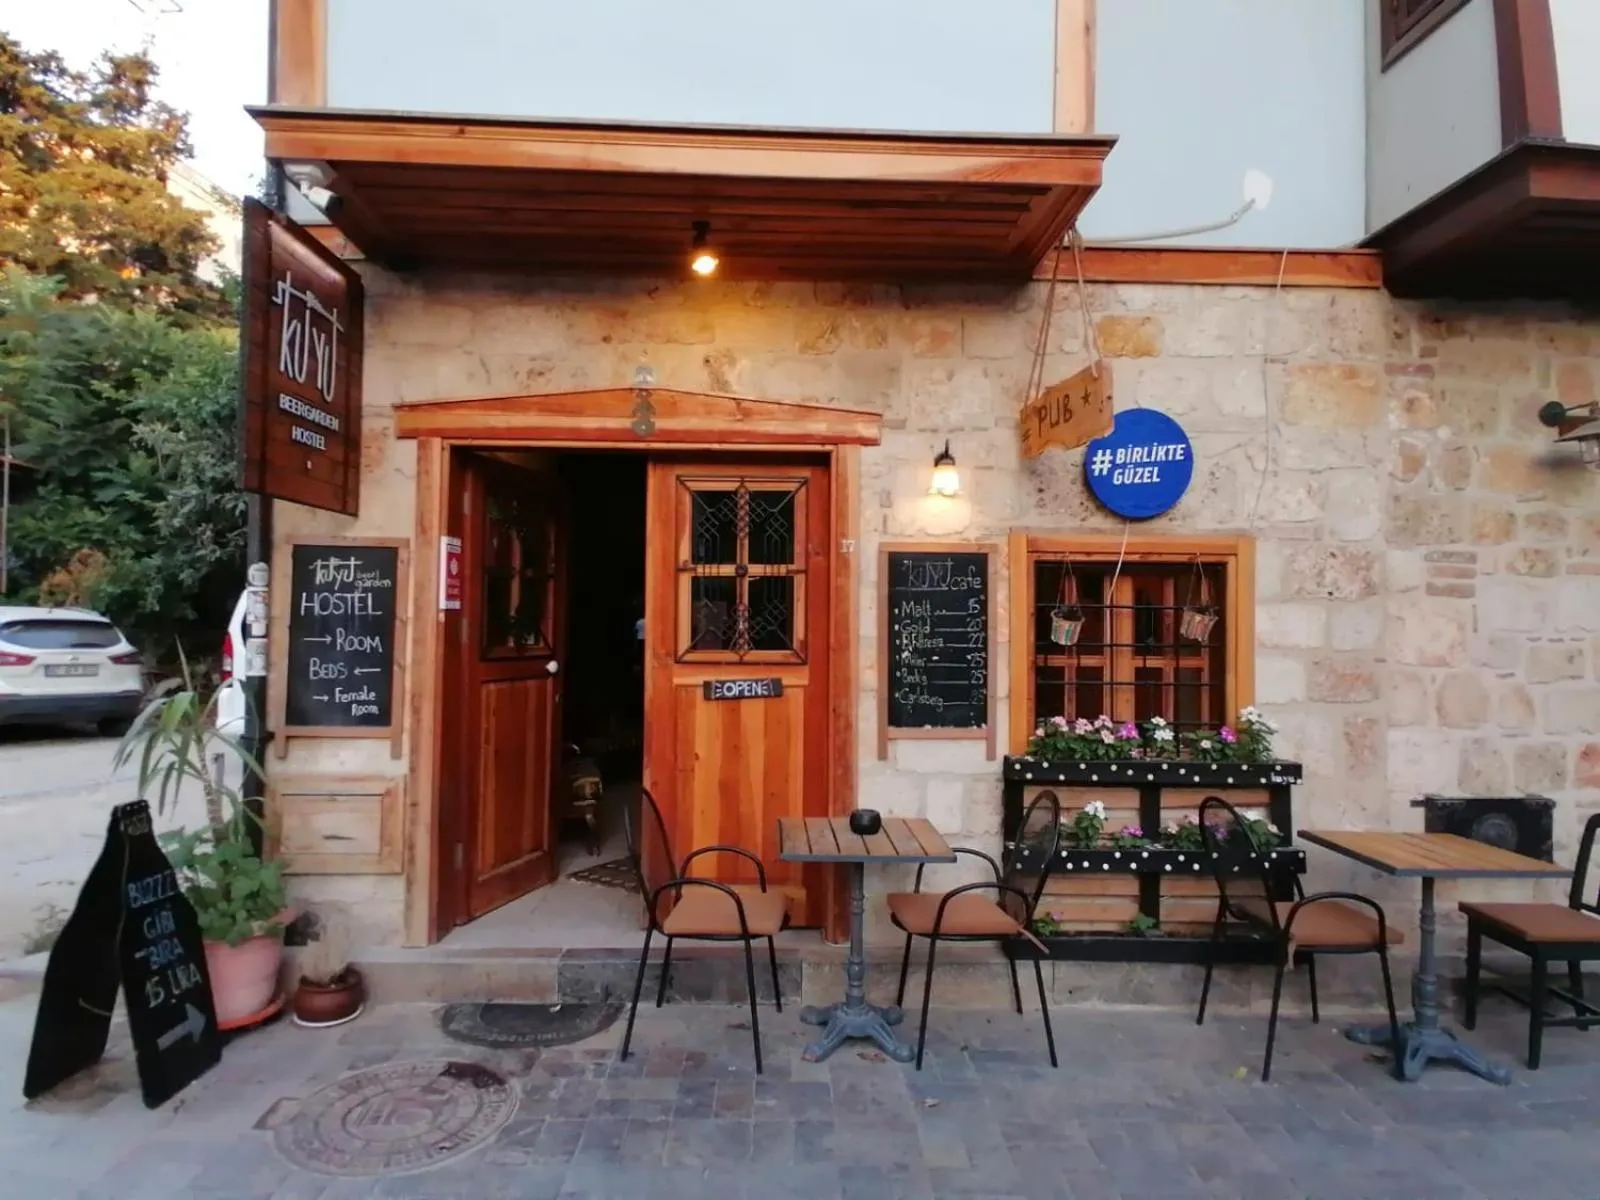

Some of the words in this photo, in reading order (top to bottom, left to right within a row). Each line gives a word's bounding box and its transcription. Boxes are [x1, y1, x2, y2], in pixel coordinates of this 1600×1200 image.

[279, 393, 339, 432] BEERGARDEN
[1037, 394, 1073, 438] PUB
[292, 425, 327, 450] HOSTEL
[1113, 464, 1161, 485] GÜZEL
[950, 565, 983, 590] cafe
[300, 592, 383, 617] HOSTEL
[901, 600, 931, 617] Malt
[899, 617, 931, 633] Gold
[336, 628, 383, 653] ROOM
[335, 685, 376, 703] Female
[723, 681, 762, 697] OPEN
